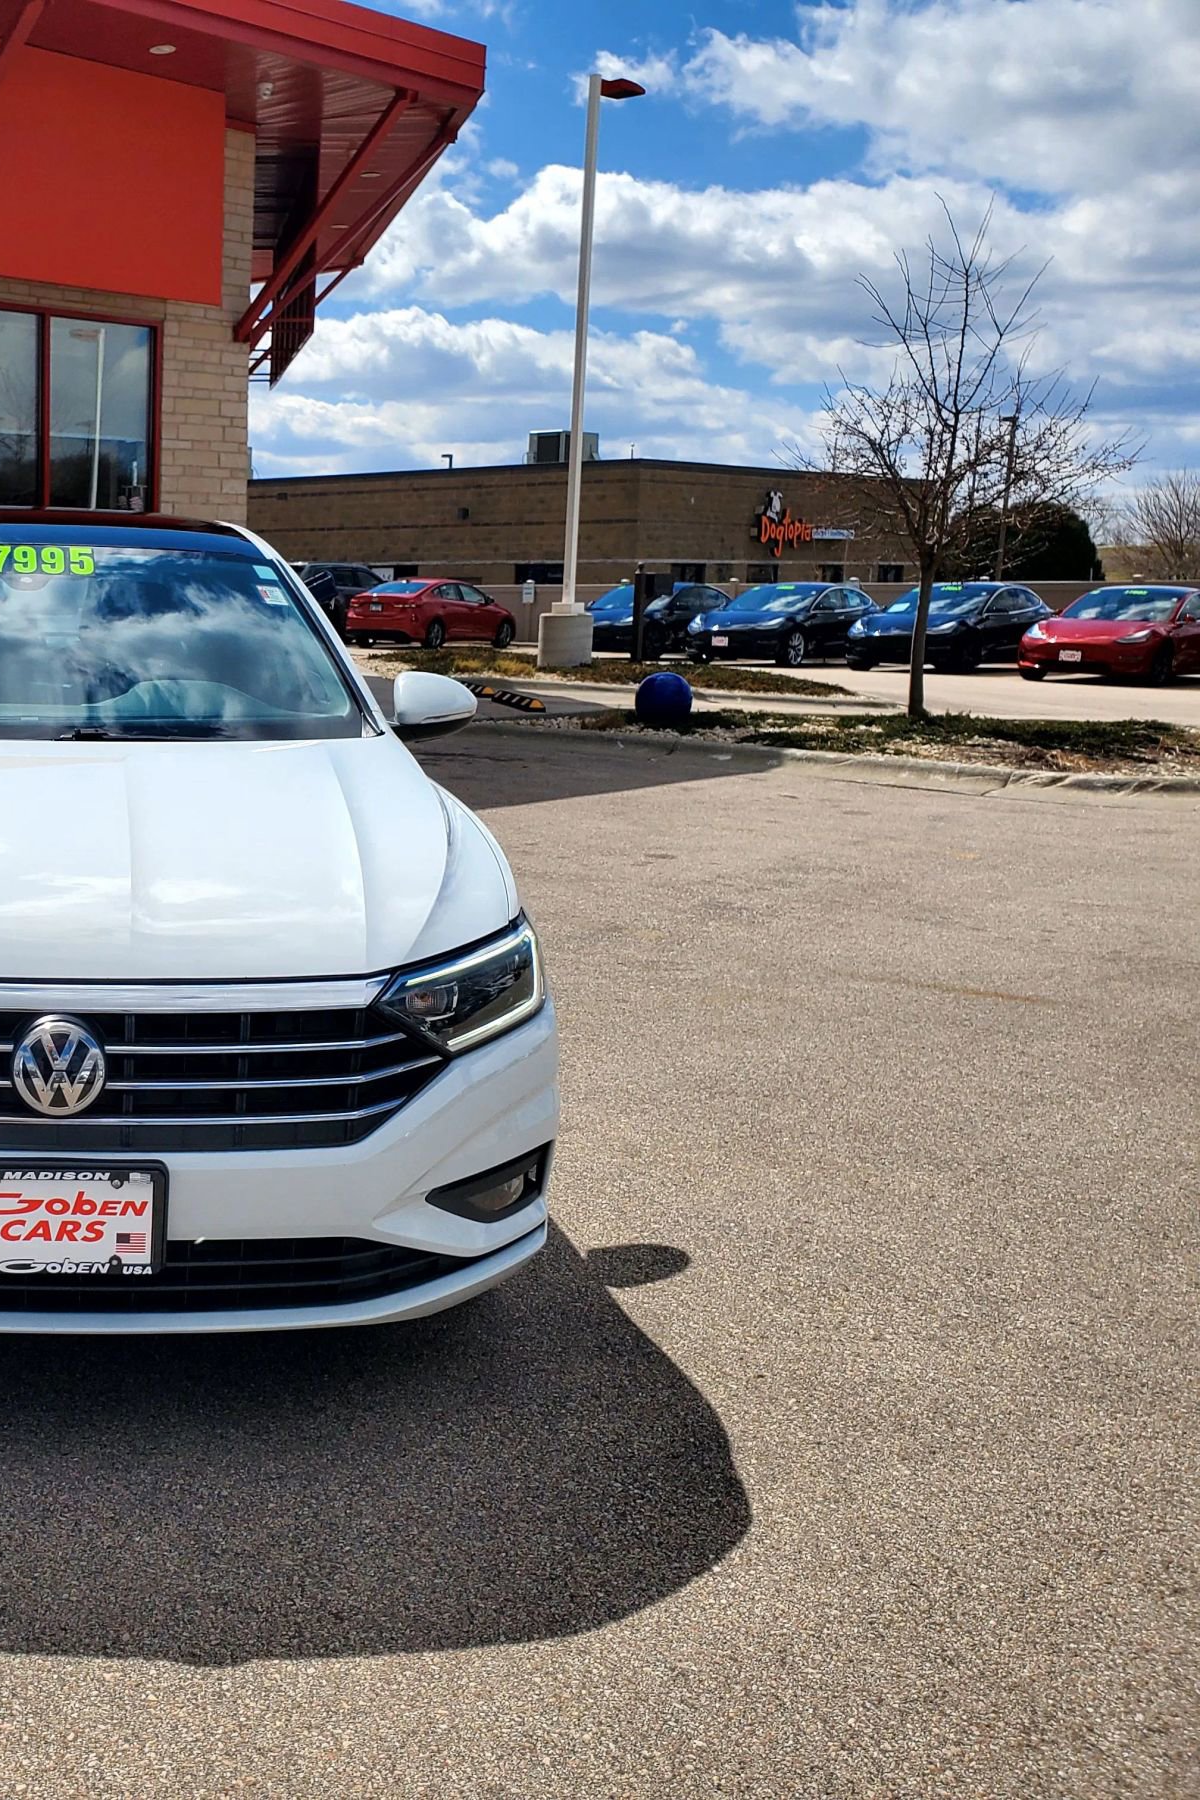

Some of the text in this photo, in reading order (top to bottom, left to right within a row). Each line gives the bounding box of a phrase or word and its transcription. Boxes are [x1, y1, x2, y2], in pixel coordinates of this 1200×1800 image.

[761, 507, 812, 558] Dogtopia
[3, 1171, 110, 1181] MADISON
[0, 1219, 108, 1243] CARS
[122, 1265, 153, 1275] USA
